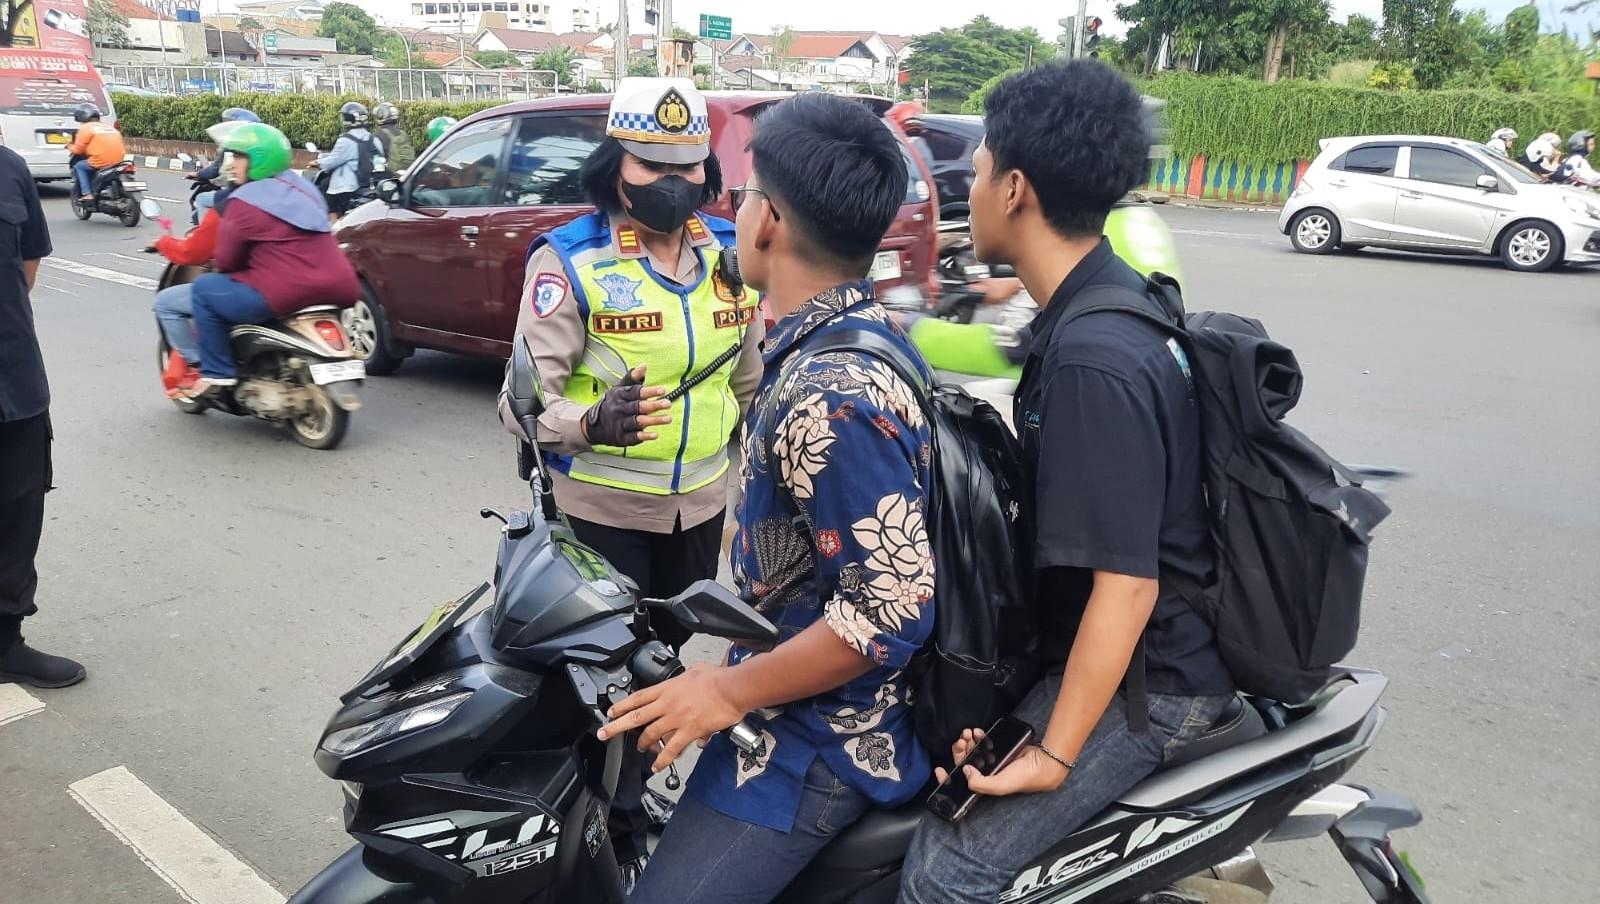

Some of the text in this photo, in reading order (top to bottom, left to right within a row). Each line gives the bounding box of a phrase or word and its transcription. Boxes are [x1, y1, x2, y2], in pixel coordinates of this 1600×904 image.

[600, 315, 657, 331] FITRI
[719, 309, 753, 326] POISI
[1128, 821, 1224, 874] LIQUID COOLED
